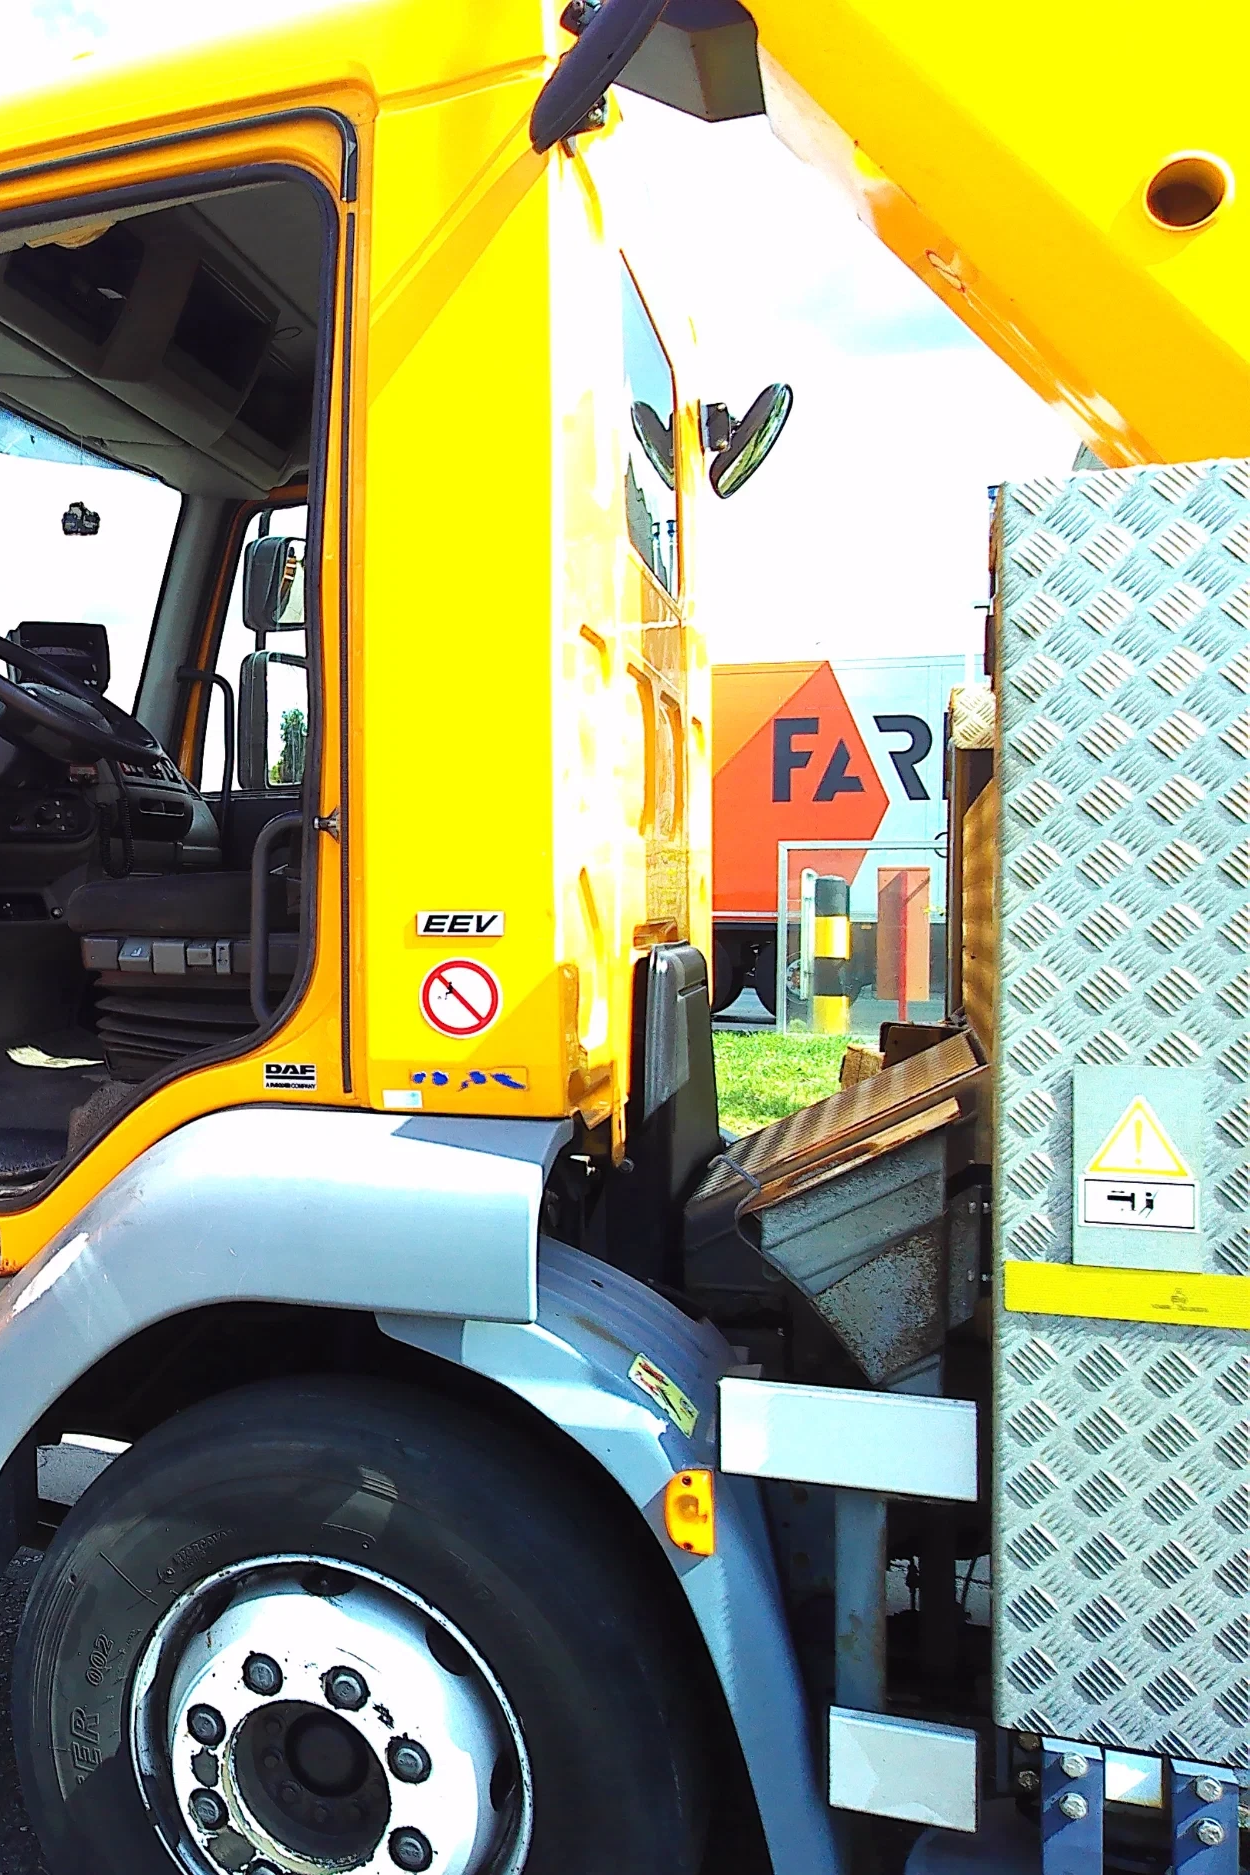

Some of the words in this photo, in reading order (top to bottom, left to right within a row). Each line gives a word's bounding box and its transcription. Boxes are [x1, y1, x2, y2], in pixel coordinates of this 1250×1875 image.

[772, 714, 949, 802] FAR
[423, 914, 498, 933] EEV
[265, 1064, 315, 1075] DAF
[85, 1633, 114, 1687] 002
